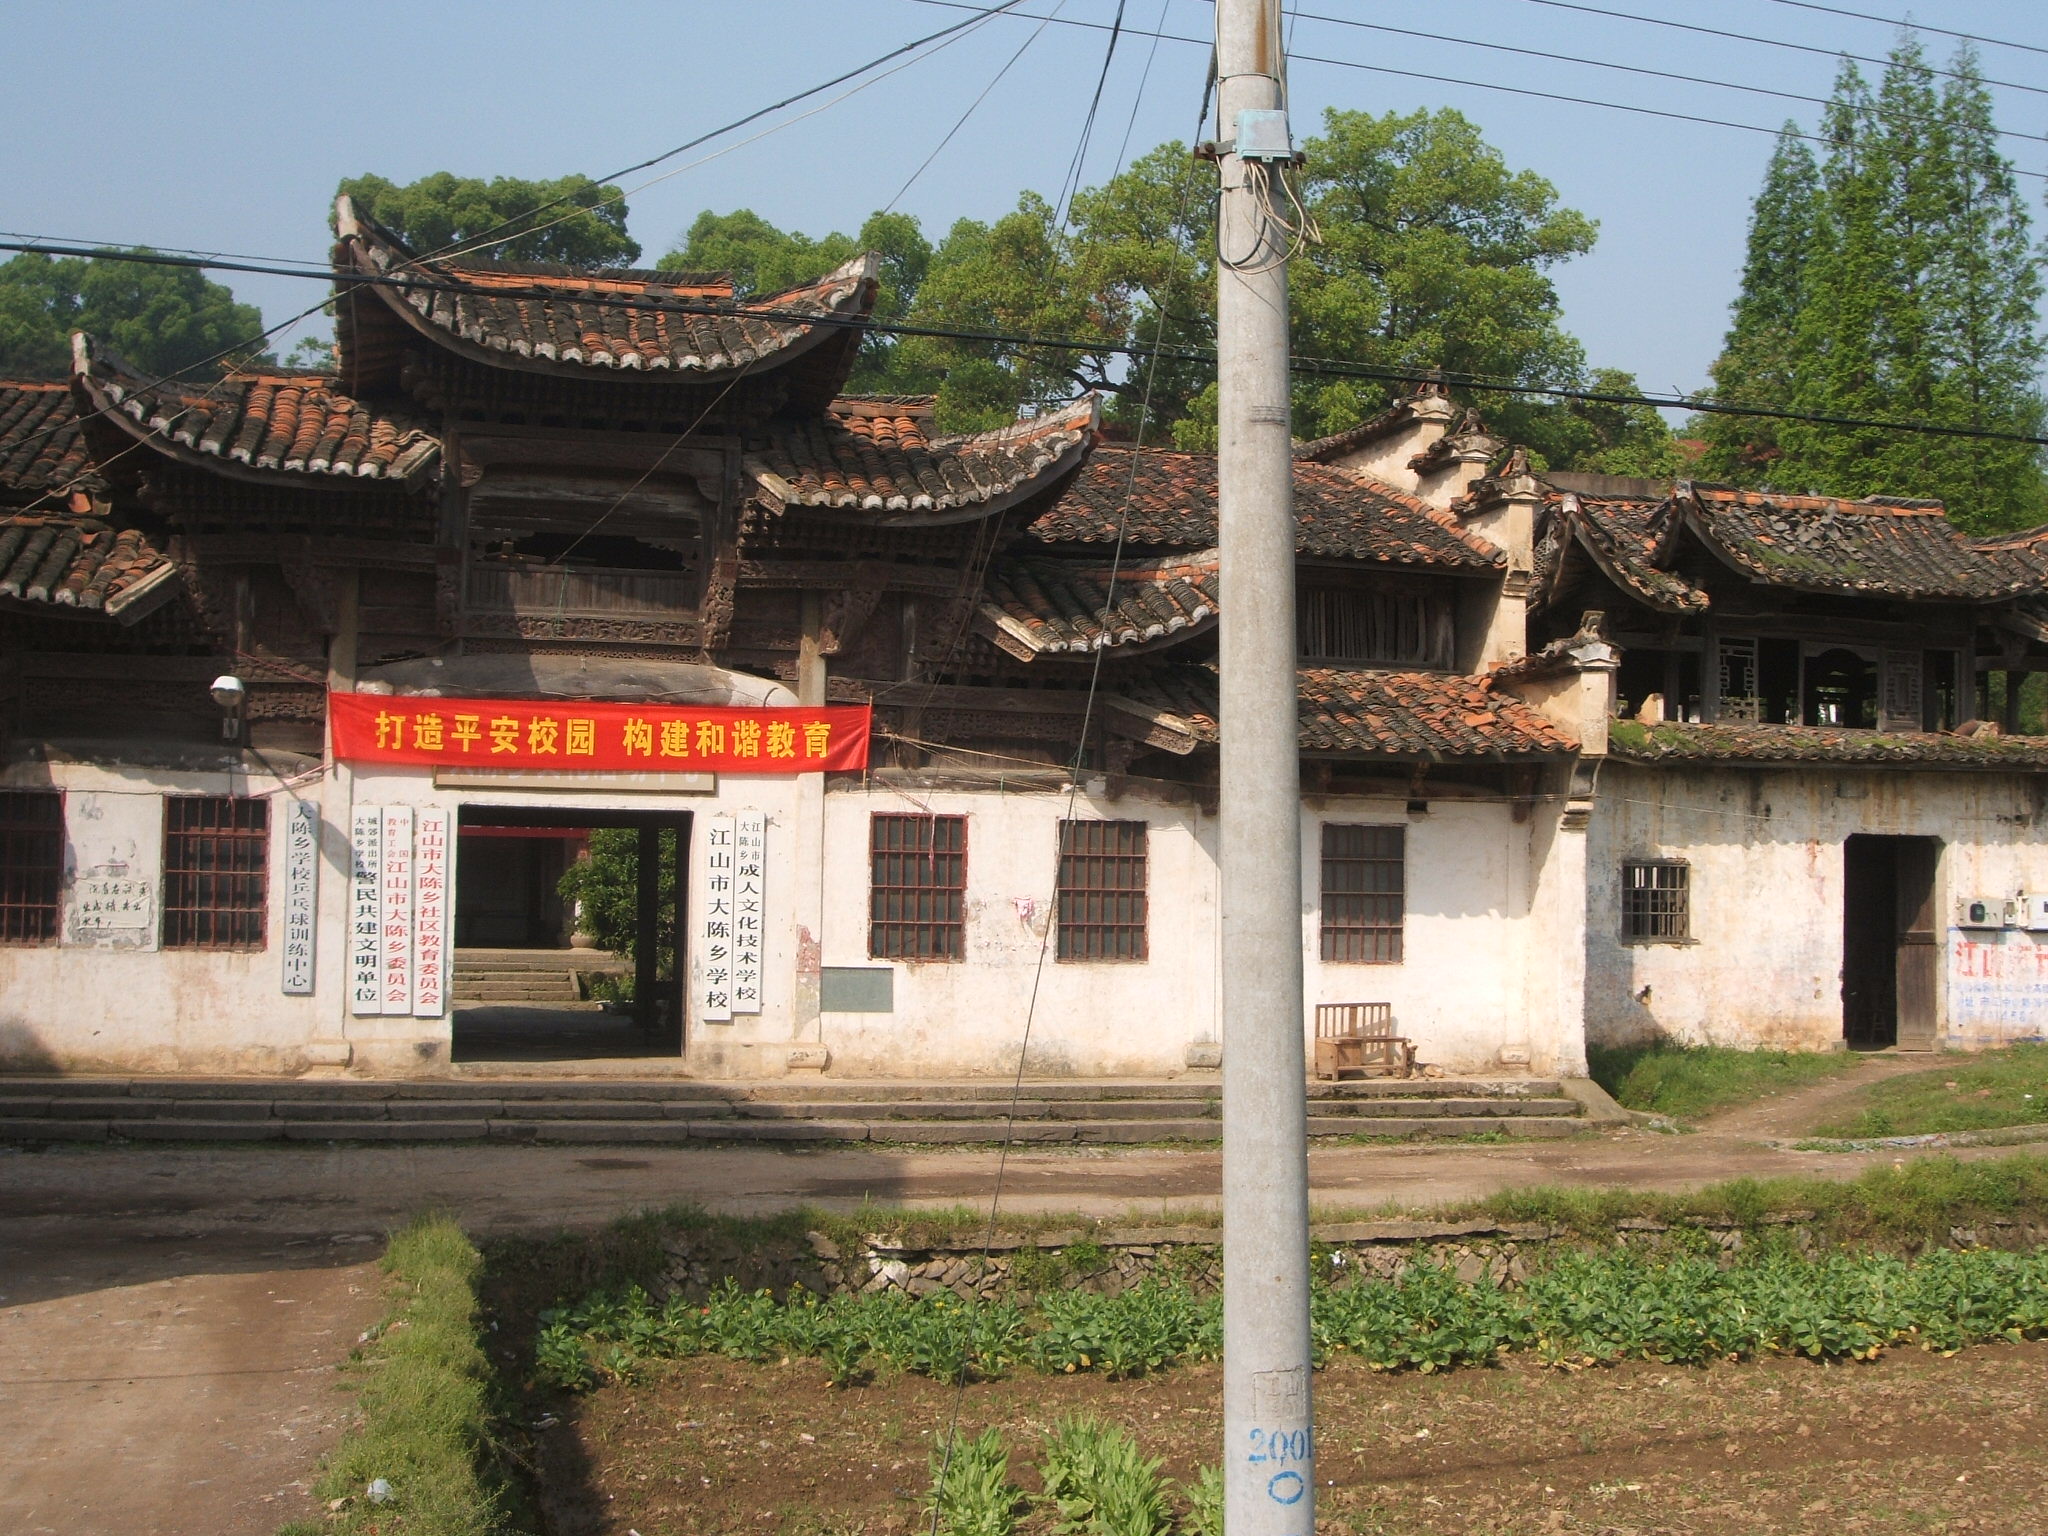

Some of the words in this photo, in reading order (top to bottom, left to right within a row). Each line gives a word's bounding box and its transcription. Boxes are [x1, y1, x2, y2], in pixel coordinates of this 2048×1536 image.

[374, 709, 596, 757] 打造平安校园
[622, 717, 831, 760] 构建和谐教育
[355, 870, 378, 1003] 警民共建文明单位
[385, 860, 409, 1003] 江山市大陈乡委员会
[418, 819, 444, 1004] 江山市大陈乡社区教育委员会
[706, 828, 731, 1009] 江山市大陈乡学校
[735, 863, 760, 1001] 成人文化技术学校
